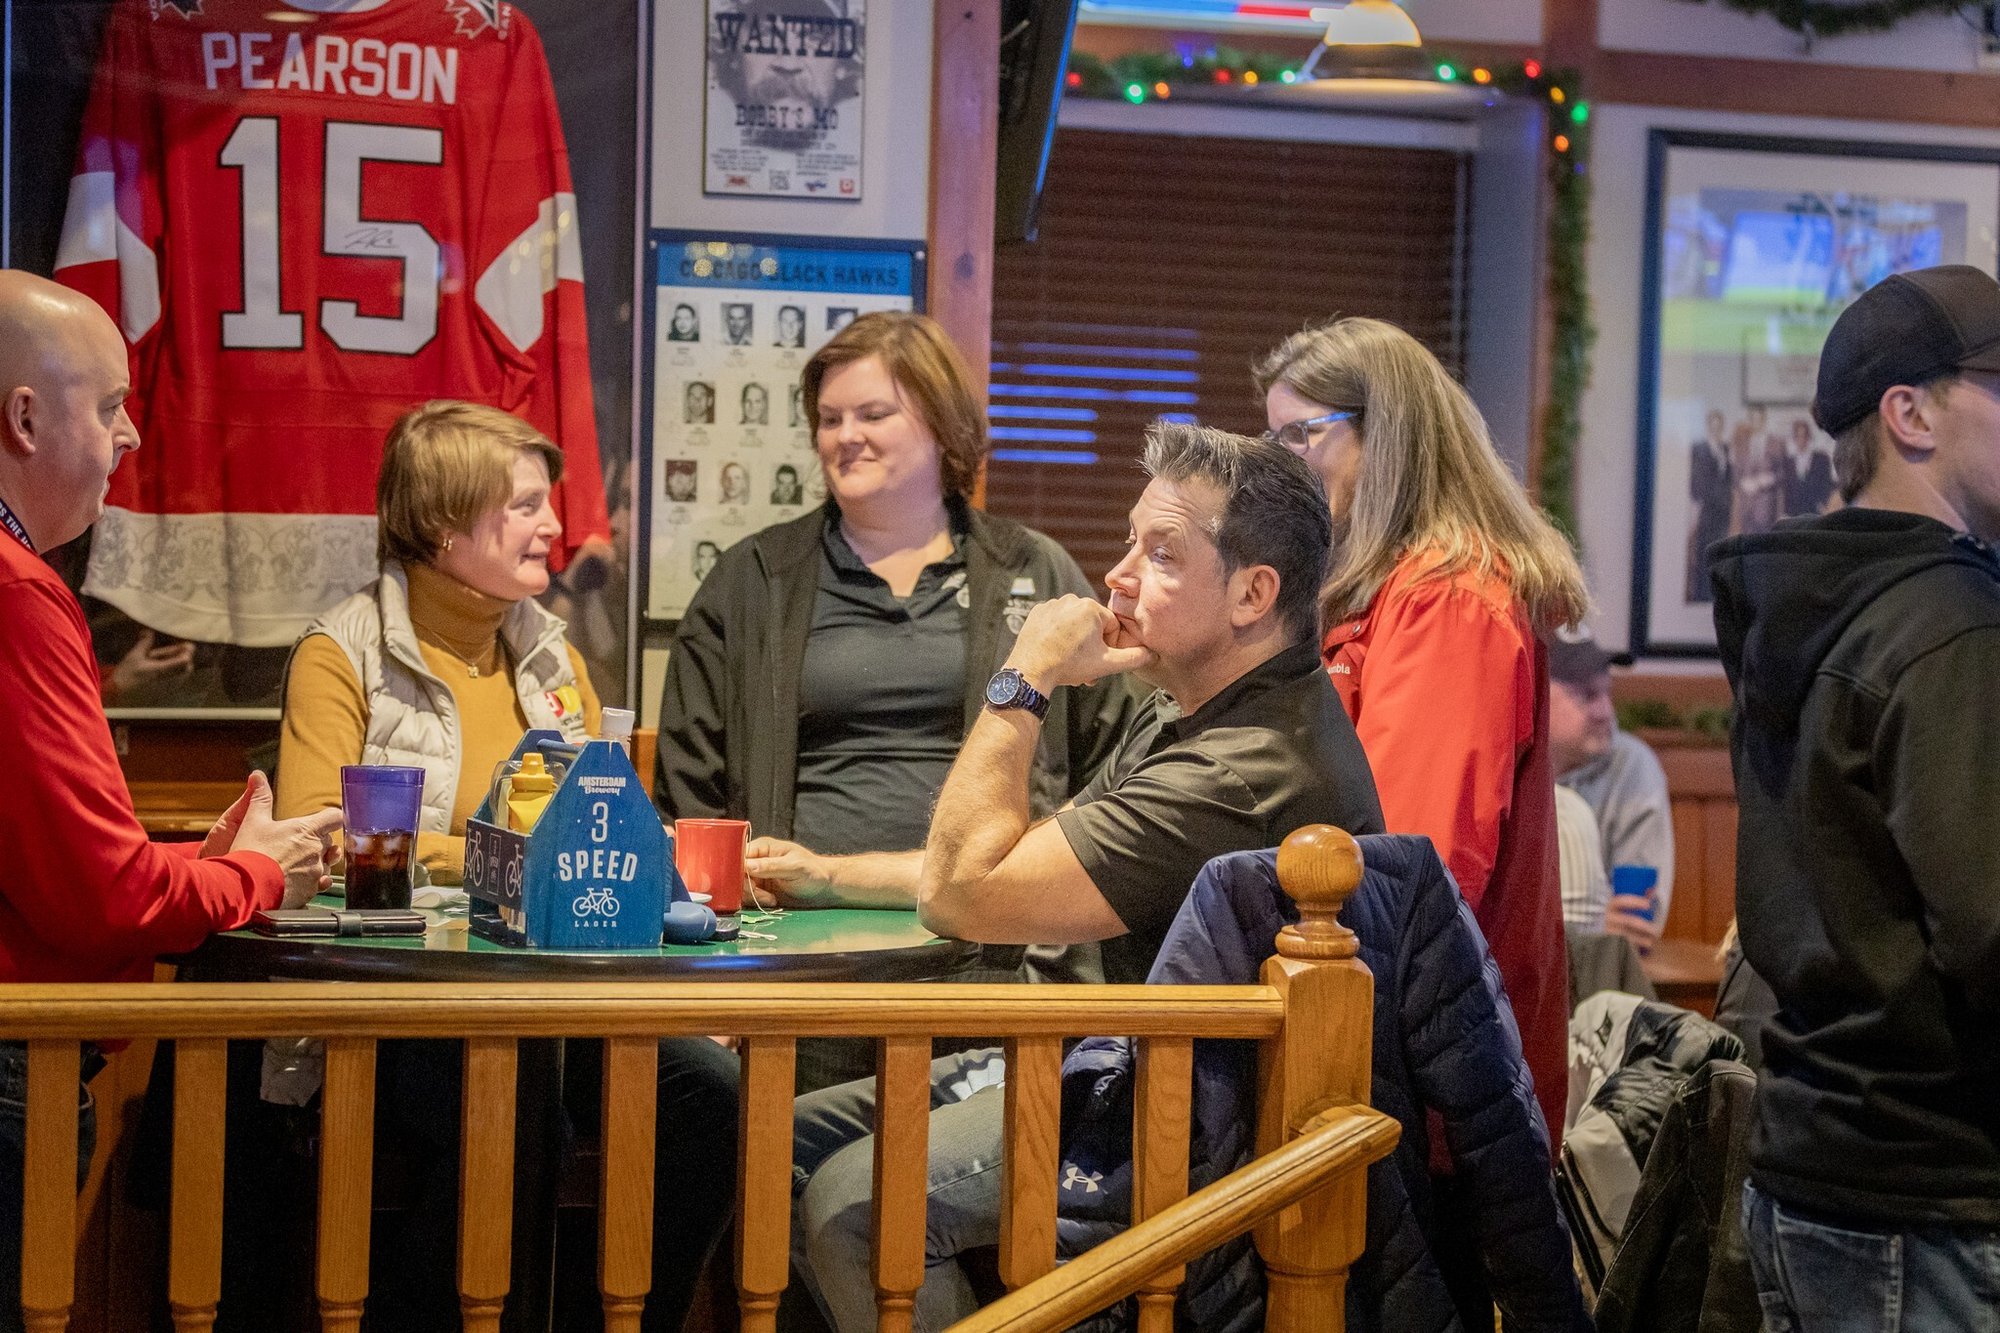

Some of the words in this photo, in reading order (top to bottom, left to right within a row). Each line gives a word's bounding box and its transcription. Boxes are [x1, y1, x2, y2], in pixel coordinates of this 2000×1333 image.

[715, 12, 856, 58] WANTED
[202, 32, 458, 105] PEARSON
[218, 116, 444, 357] 15
[834, 266, 899, 287] HAWKS
[6, 516, 23, 538] THE
[578, 776, 626, 787] AMSTERDAM
[584, 786, 621, 796] Brewery
[592, 801, 609, 843] 3
[557, 849, 638, 882] SPEED
